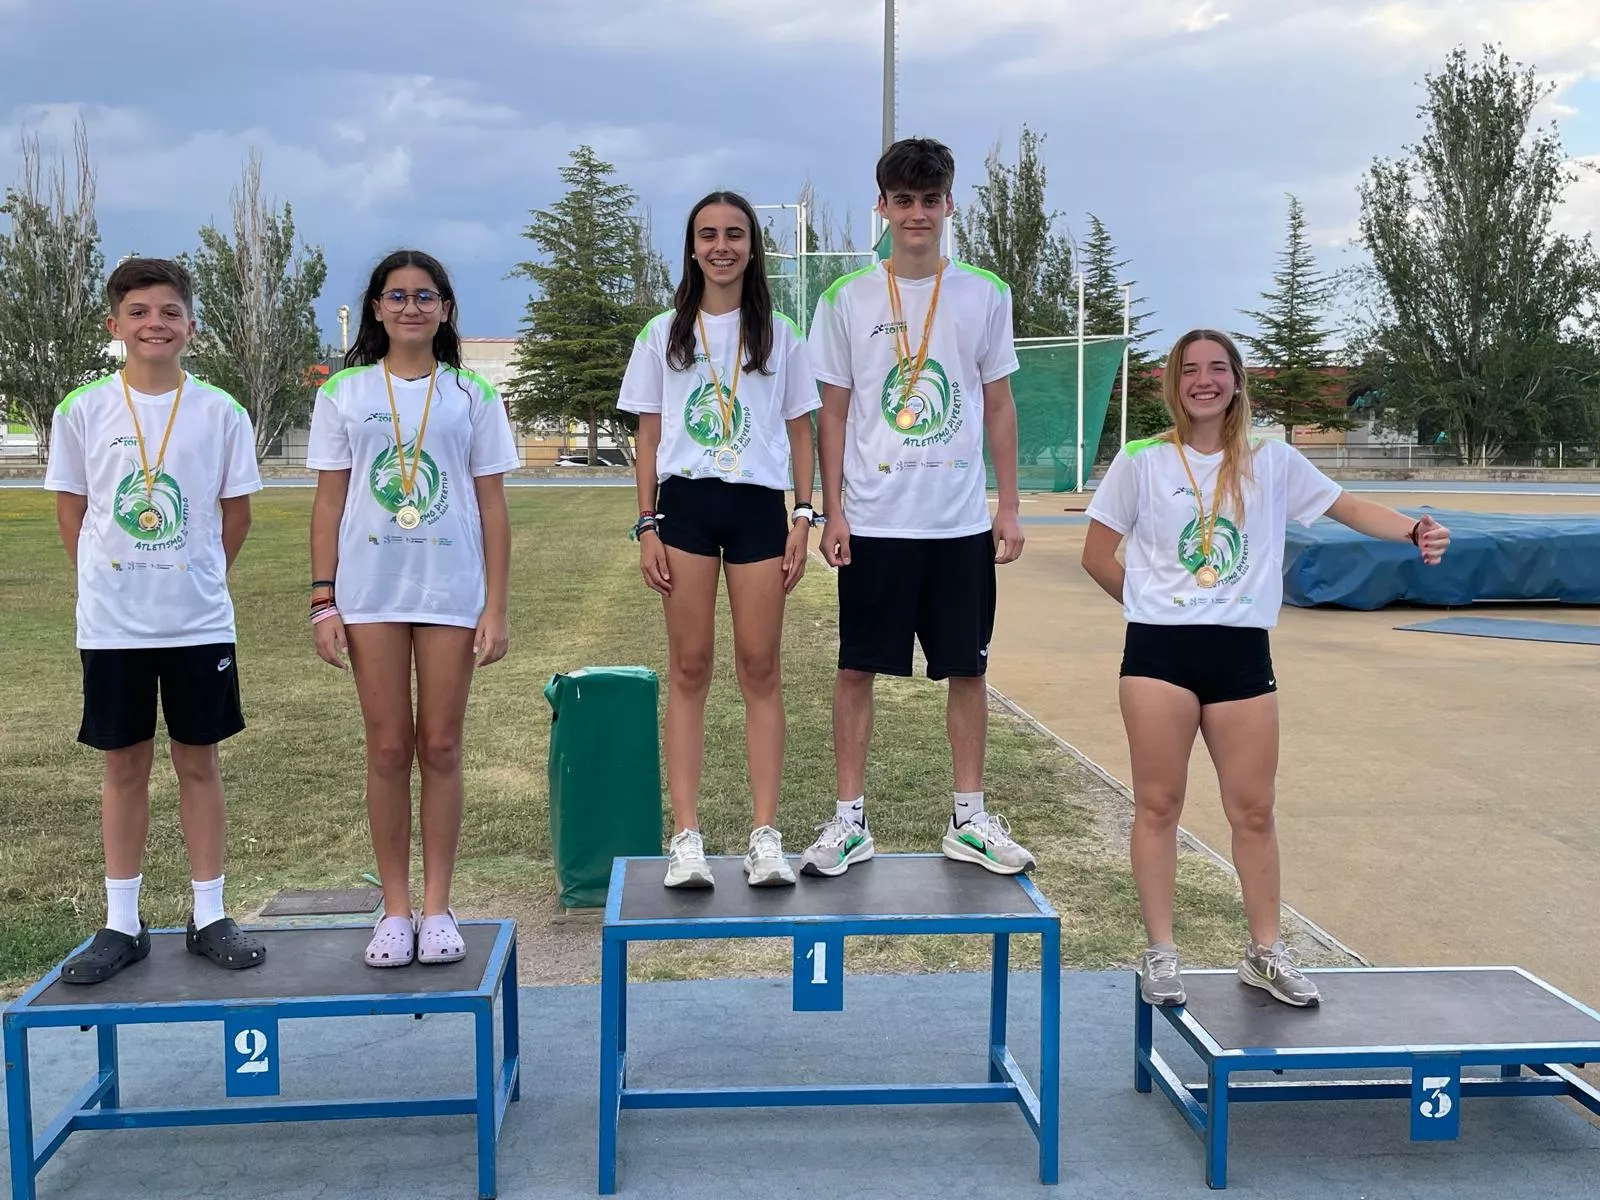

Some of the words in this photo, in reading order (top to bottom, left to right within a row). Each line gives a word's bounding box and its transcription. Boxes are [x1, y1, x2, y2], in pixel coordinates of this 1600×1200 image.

[737, 406, 751, 443] DIVERTIDO
[903, 428, 949, 447] ATLETISMO
[947, 381, 962, 428] DIVERTIDO
[434, 471, 448, 510] DIVERTIDO
[135, 535, 182, 551] ATLETISMO
[1237, 534, 1249, 572] DIVERTIDO
[806, 942, 828, 984] 1
[234, 1029, 269, 1073] 2
[1420, 1077, 1452, 1118] 3
